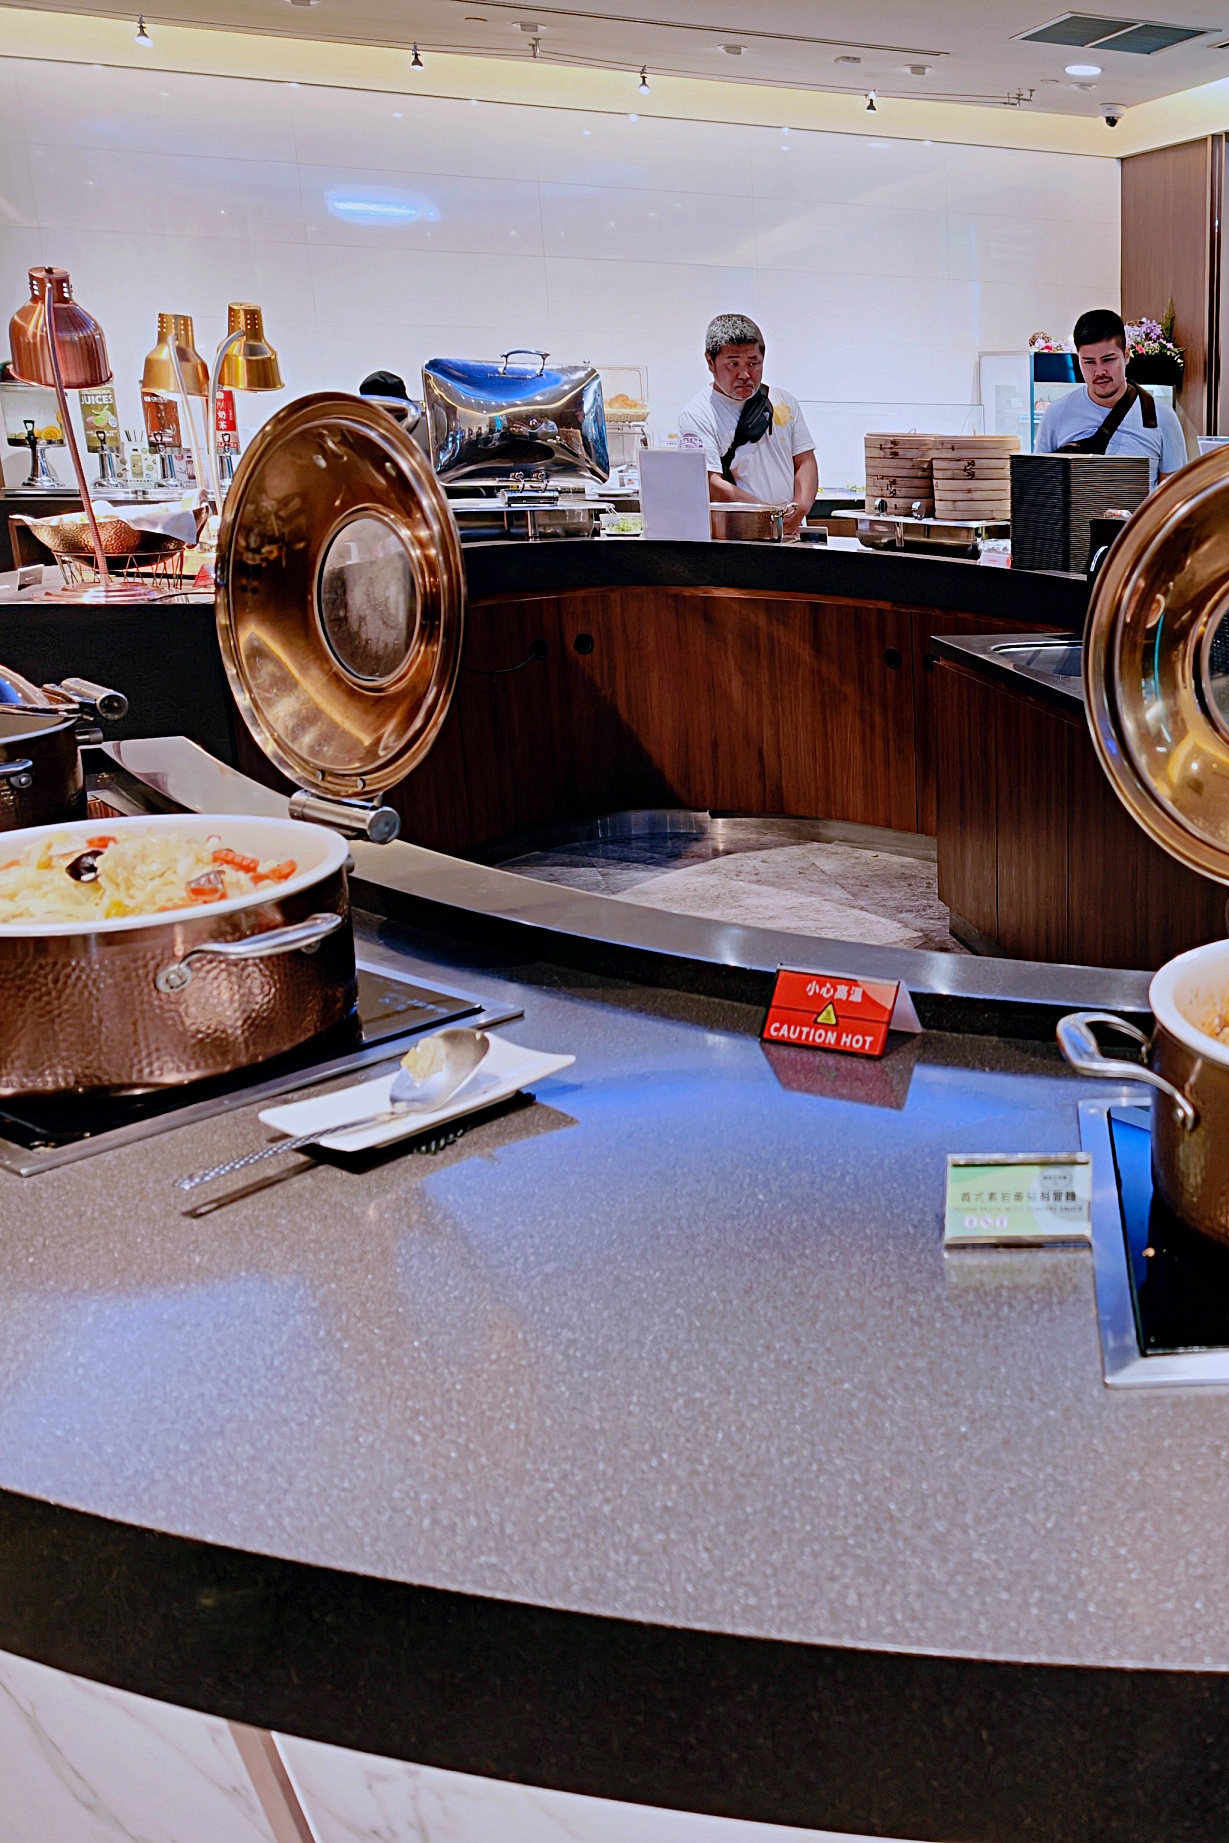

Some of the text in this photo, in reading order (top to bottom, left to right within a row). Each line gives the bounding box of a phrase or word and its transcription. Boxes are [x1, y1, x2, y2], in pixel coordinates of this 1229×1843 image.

[81, 395, 114, 405] JUICES
[806, 980, 863, 1003] 小心高溫
[770, 1022, 874, 1050] CAUTION HOT
